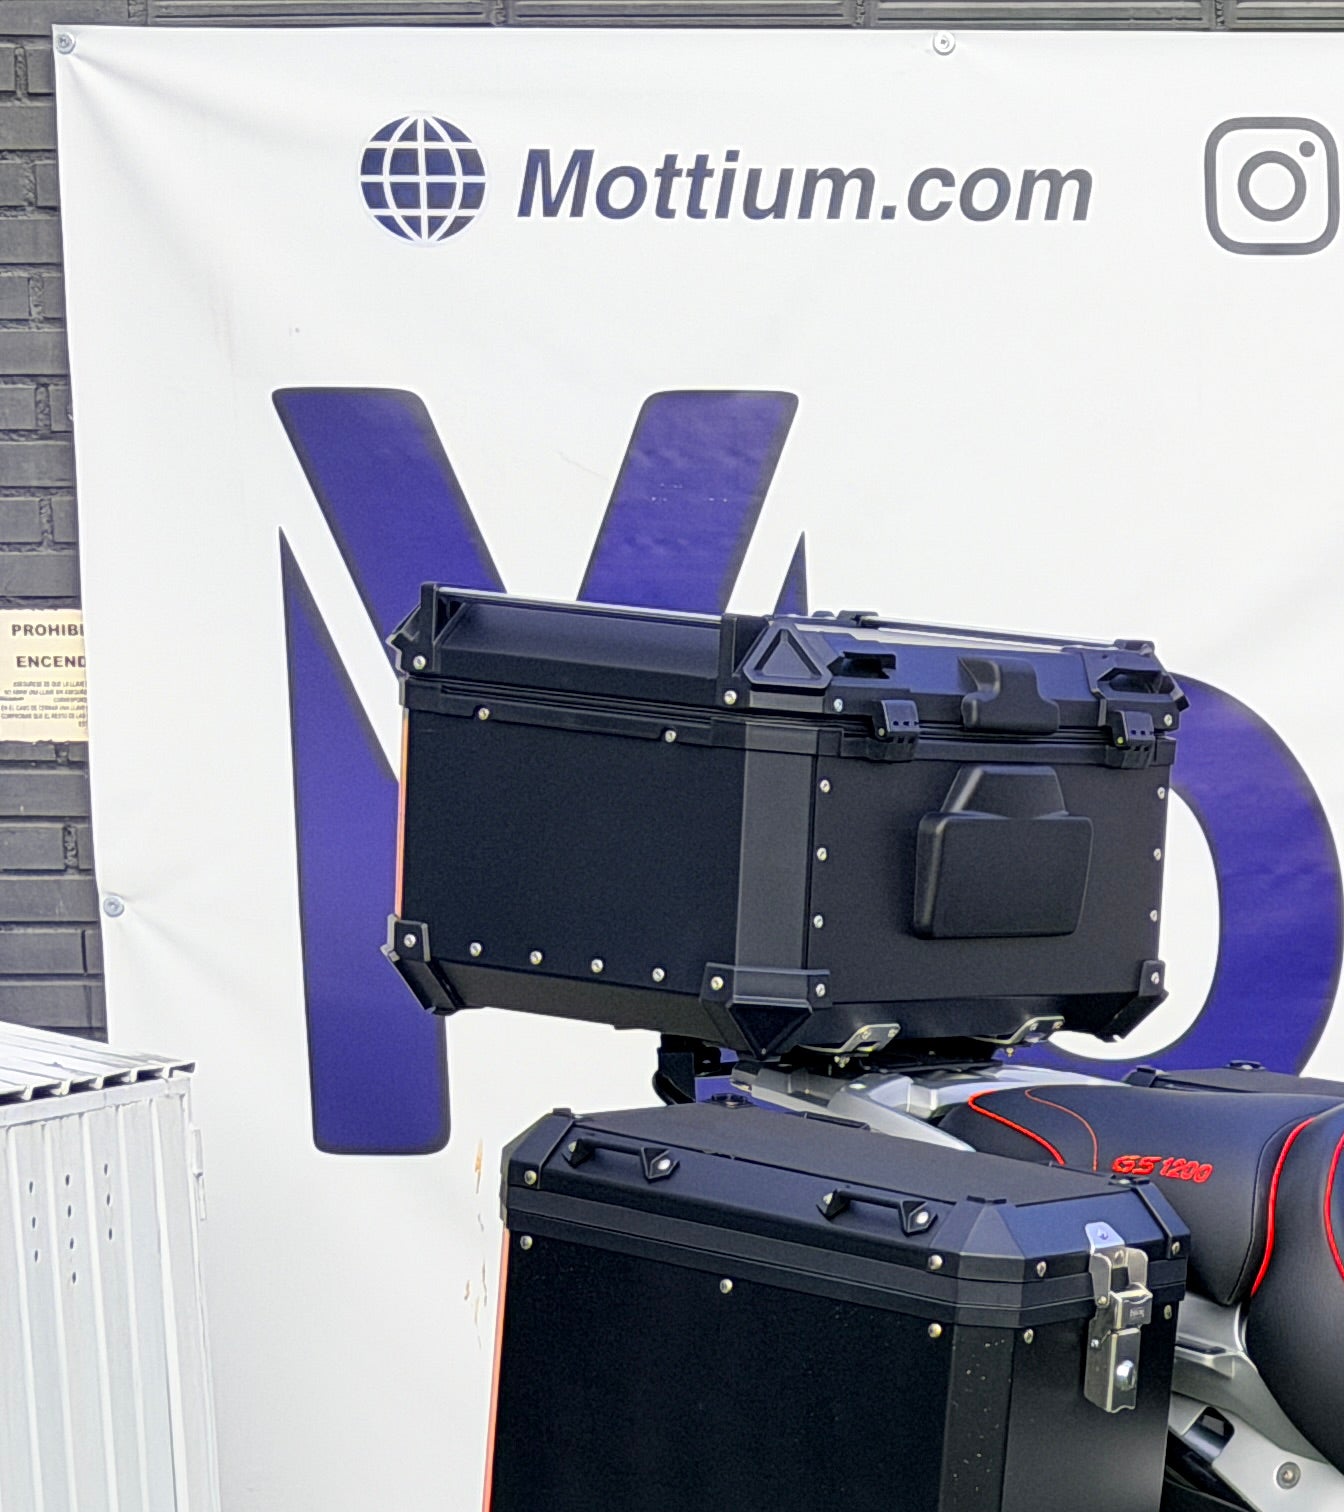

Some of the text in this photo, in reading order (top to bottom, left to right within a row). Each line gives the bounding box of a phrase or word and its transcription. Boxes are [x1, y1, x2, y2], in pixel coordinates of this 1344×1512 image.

[517, 148, 1094, 222] Mottium.com
[1112, 1154, 1214, 1184] GS 1200
